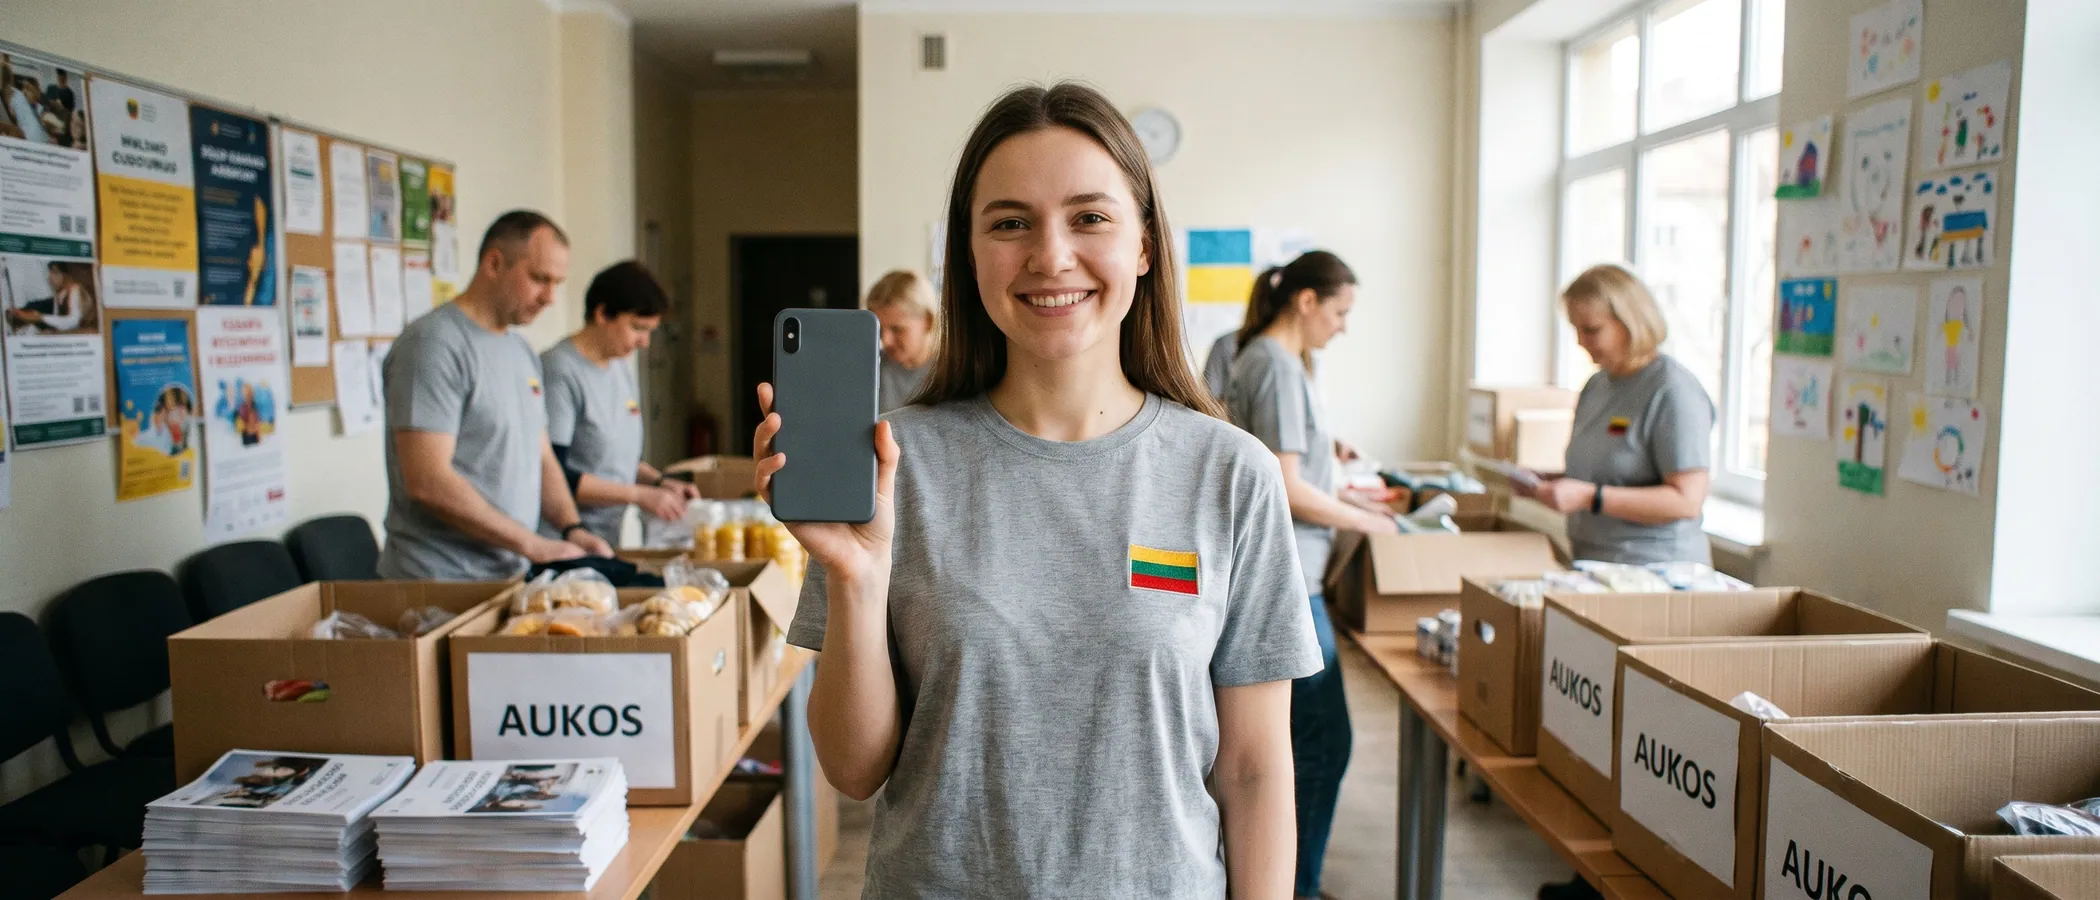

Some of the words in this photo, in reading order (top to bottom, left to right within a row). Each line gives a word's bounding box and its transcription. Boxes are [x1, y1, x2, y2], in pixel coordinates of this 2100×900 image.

[1550, 659, 1602, 717] AUKOS
[498, 704, 643, 737] AUKOS
[1634, 733, 1716, 810] AUKOS
